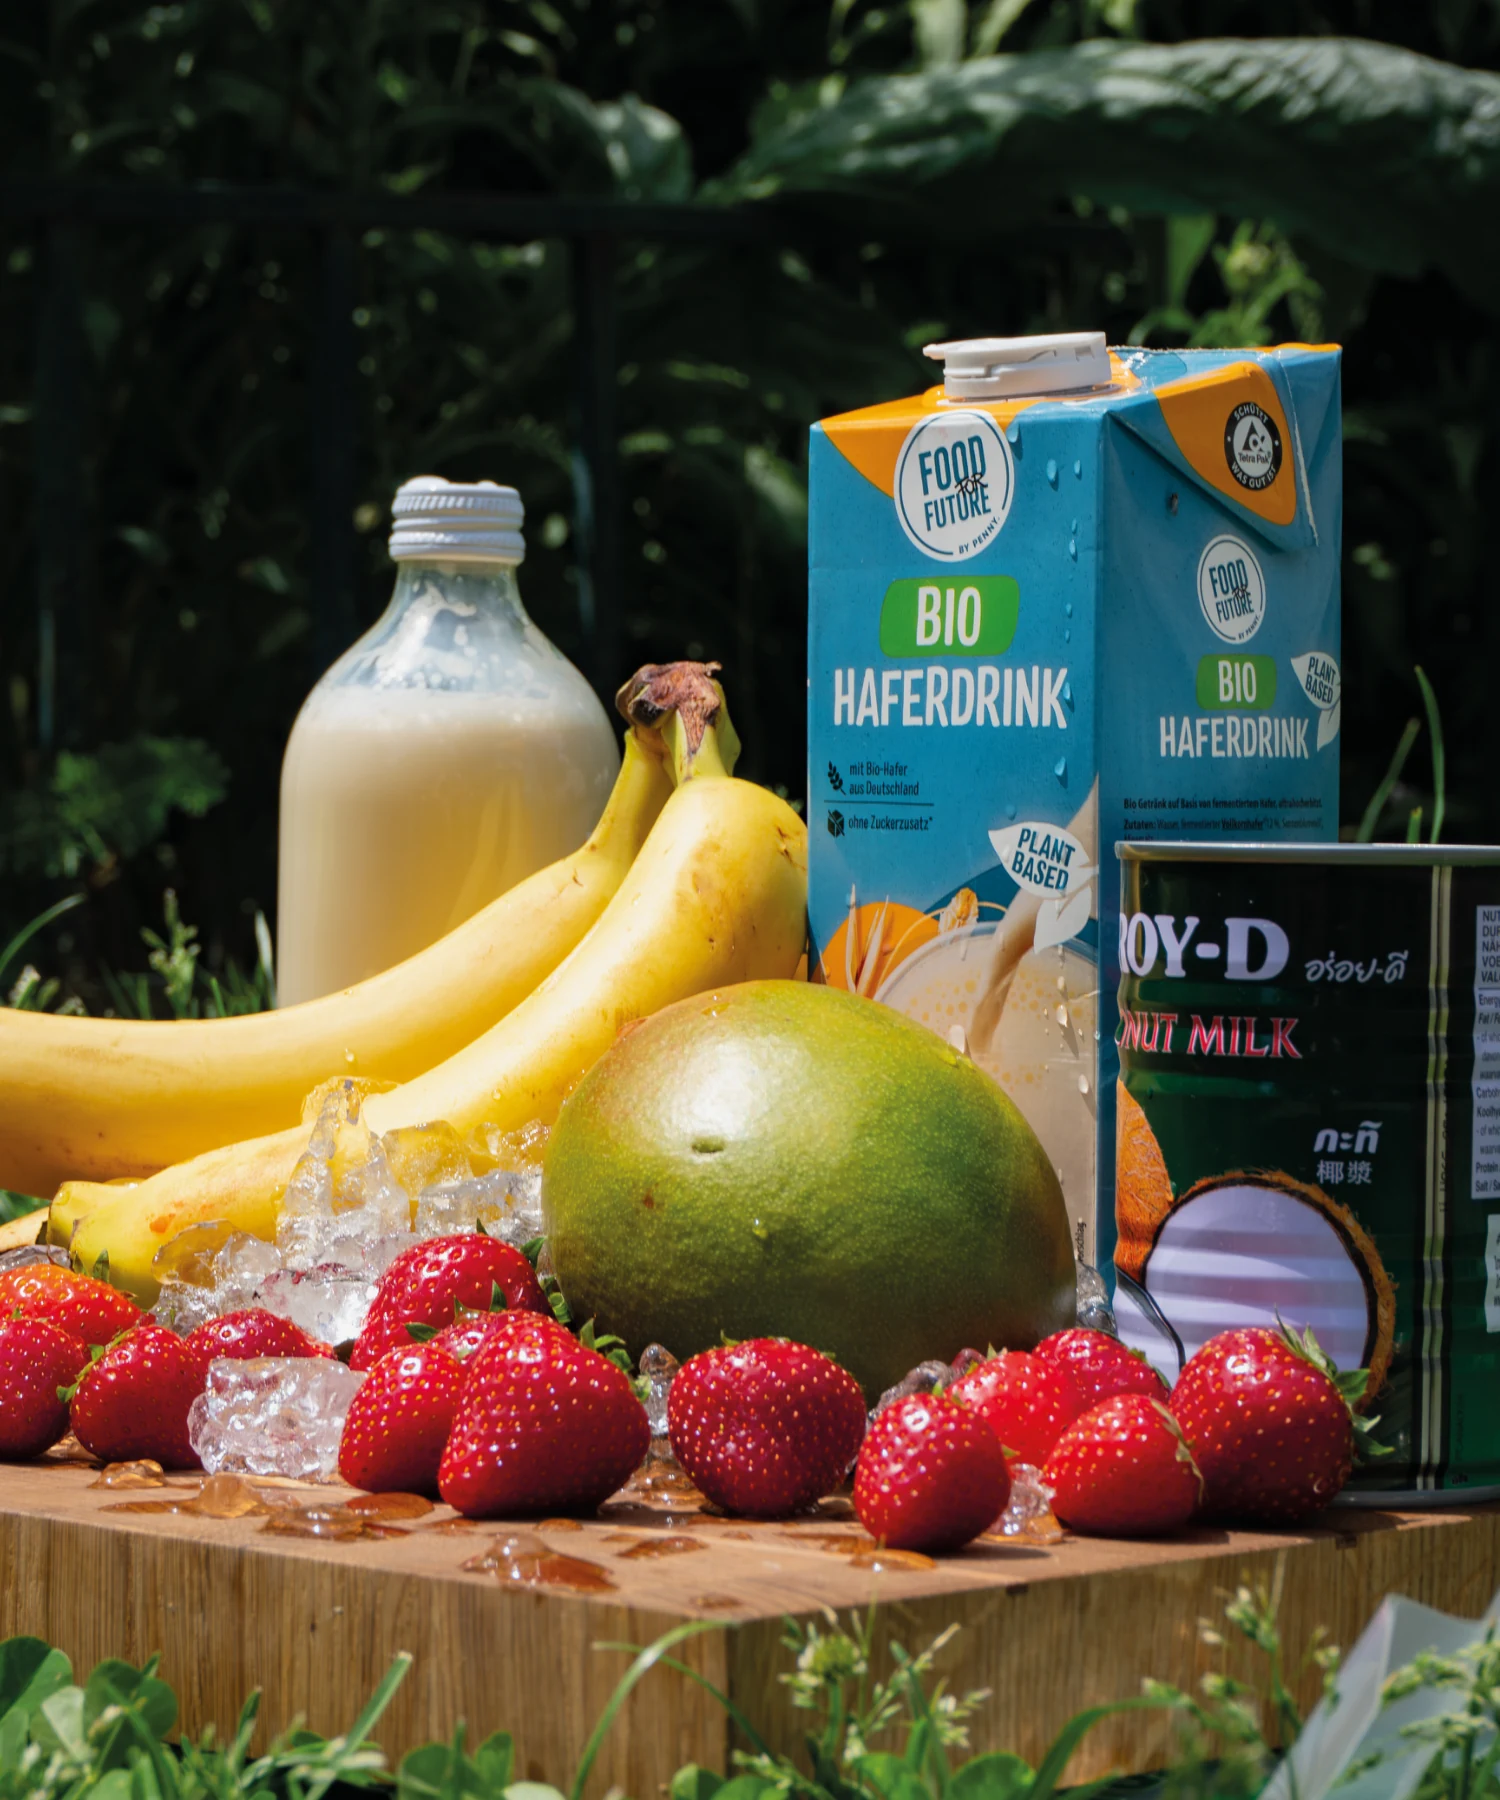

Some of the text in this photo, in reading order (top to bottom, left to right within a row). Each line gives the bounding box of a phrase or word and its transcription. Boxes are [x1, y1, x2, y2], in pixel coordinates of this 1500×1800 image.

[918, 434, 987, 496] FOOD
[1238, 452, 1255, 464] Tetra
[954, 472, 988, 497] FOR
[1231, 461, 1276, 489] WAS GUT IST
[923, 484, 991, 532] FUTURE
[958, 543, 969, 554] BY
[1208, 558, 1249, 598] FOOD
[916, 585, 982, 647] BIO
[1215, 591, 1255, 624] FUTURE
[1238, 632, 1245, 640] BY
[1218, 660, 1257, 703] BIO
[1307, 655, 1337, 686] PLANT
[833, 665, 1068, 729] HAFERDRINK
[1305, 671, 1334, 705] BASED
[1159, 715, 1309, 760] HAFERDRINK
[849, 761, 908, 777] mit Bio-Hafer
[849, 780, 919, 797] aus Deutschland
[1123, 797, 1137, 809] Bio
[1138, 797, 1167, 809] Getränk
[1168, 797, 1179, 809] auf
[1180, 797, 1197, 809] Basis
[1199, 799, 1211, 809] von
[848, 814, 869, 830] ohne
[1123, 818, 1156, 830] Zutaten:
[1017, 827, 1076, 868] PLANT
[1011, 850, 1070, 891] BASED
[1187, 1014, 1302, 1059] MILK
[1476, 1162, 1499, 1174] Protein
